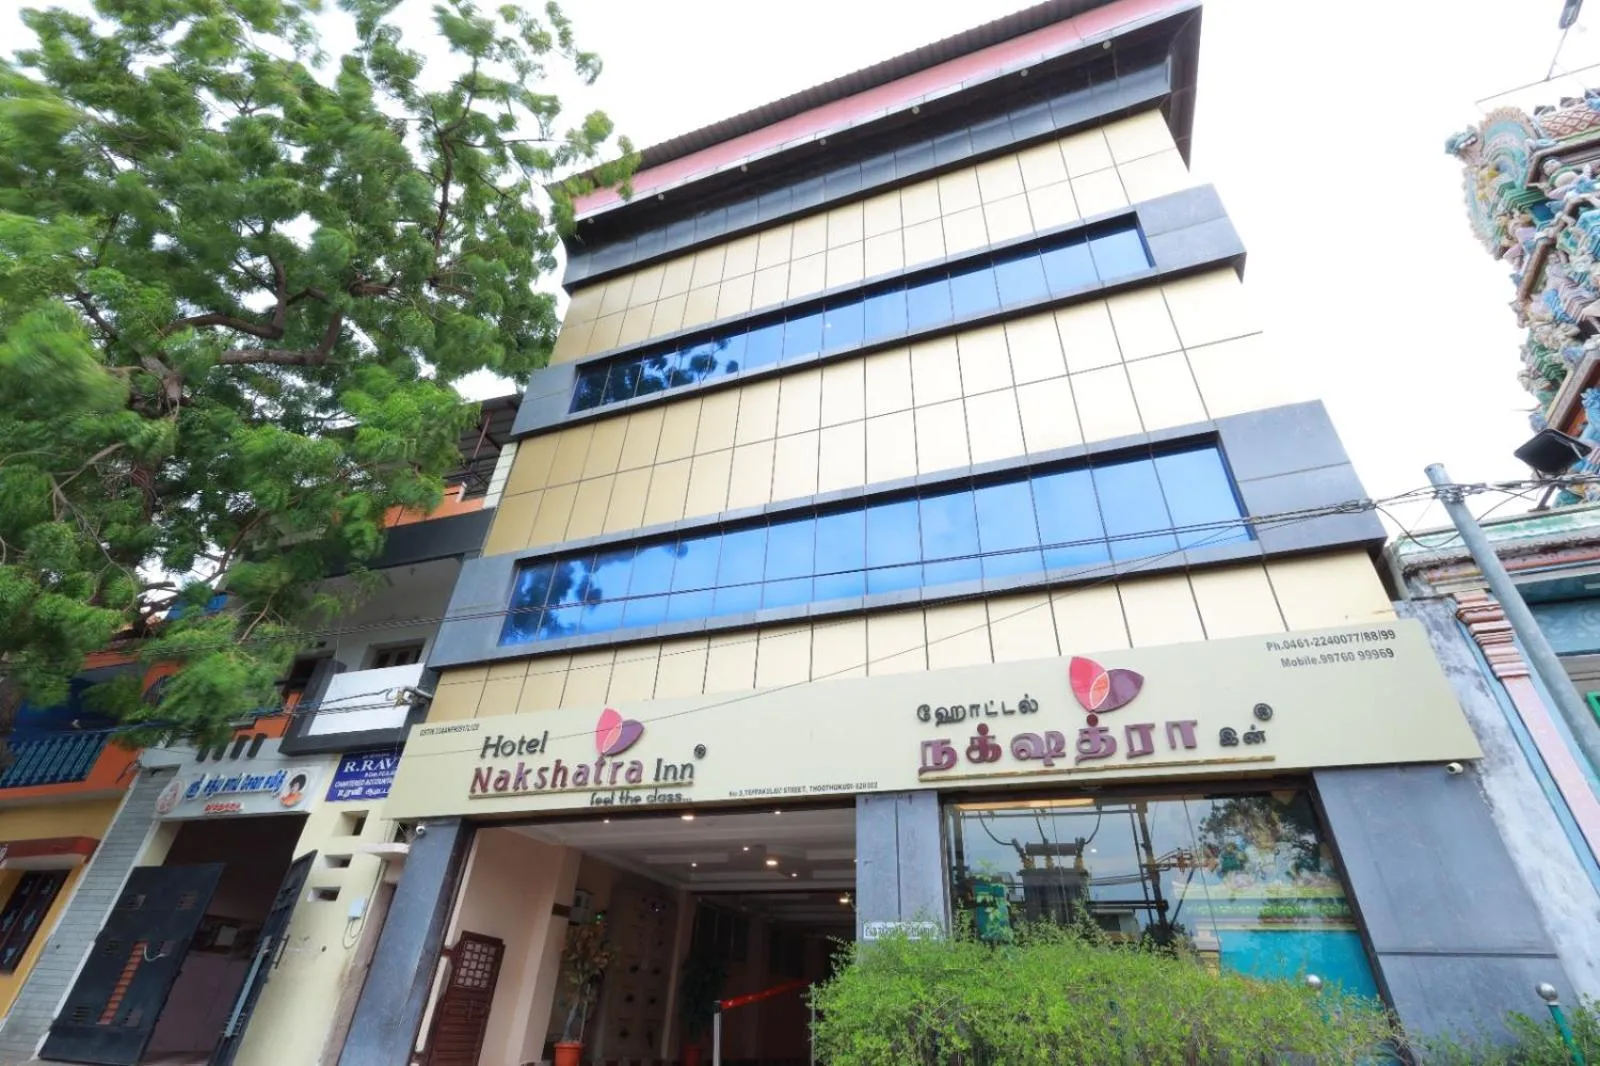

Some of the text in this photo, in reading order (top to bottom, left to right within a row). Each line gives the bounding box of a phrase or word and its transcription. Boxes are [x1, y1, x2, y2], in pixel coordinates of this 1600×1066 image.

[1266, 629, 1396, 651] Ph.0461-2240077/88/99
[917, 693, 1039, 726] ஹோட்டல்
[480, 730, 549, 759] Hotel
[1219, 725, 1267, 747] இன்
[343, 757, 398, 773] R.RAV
[469, 756, 696, 794] Nakshatra Inn
[619, 790, 642, 804] the
